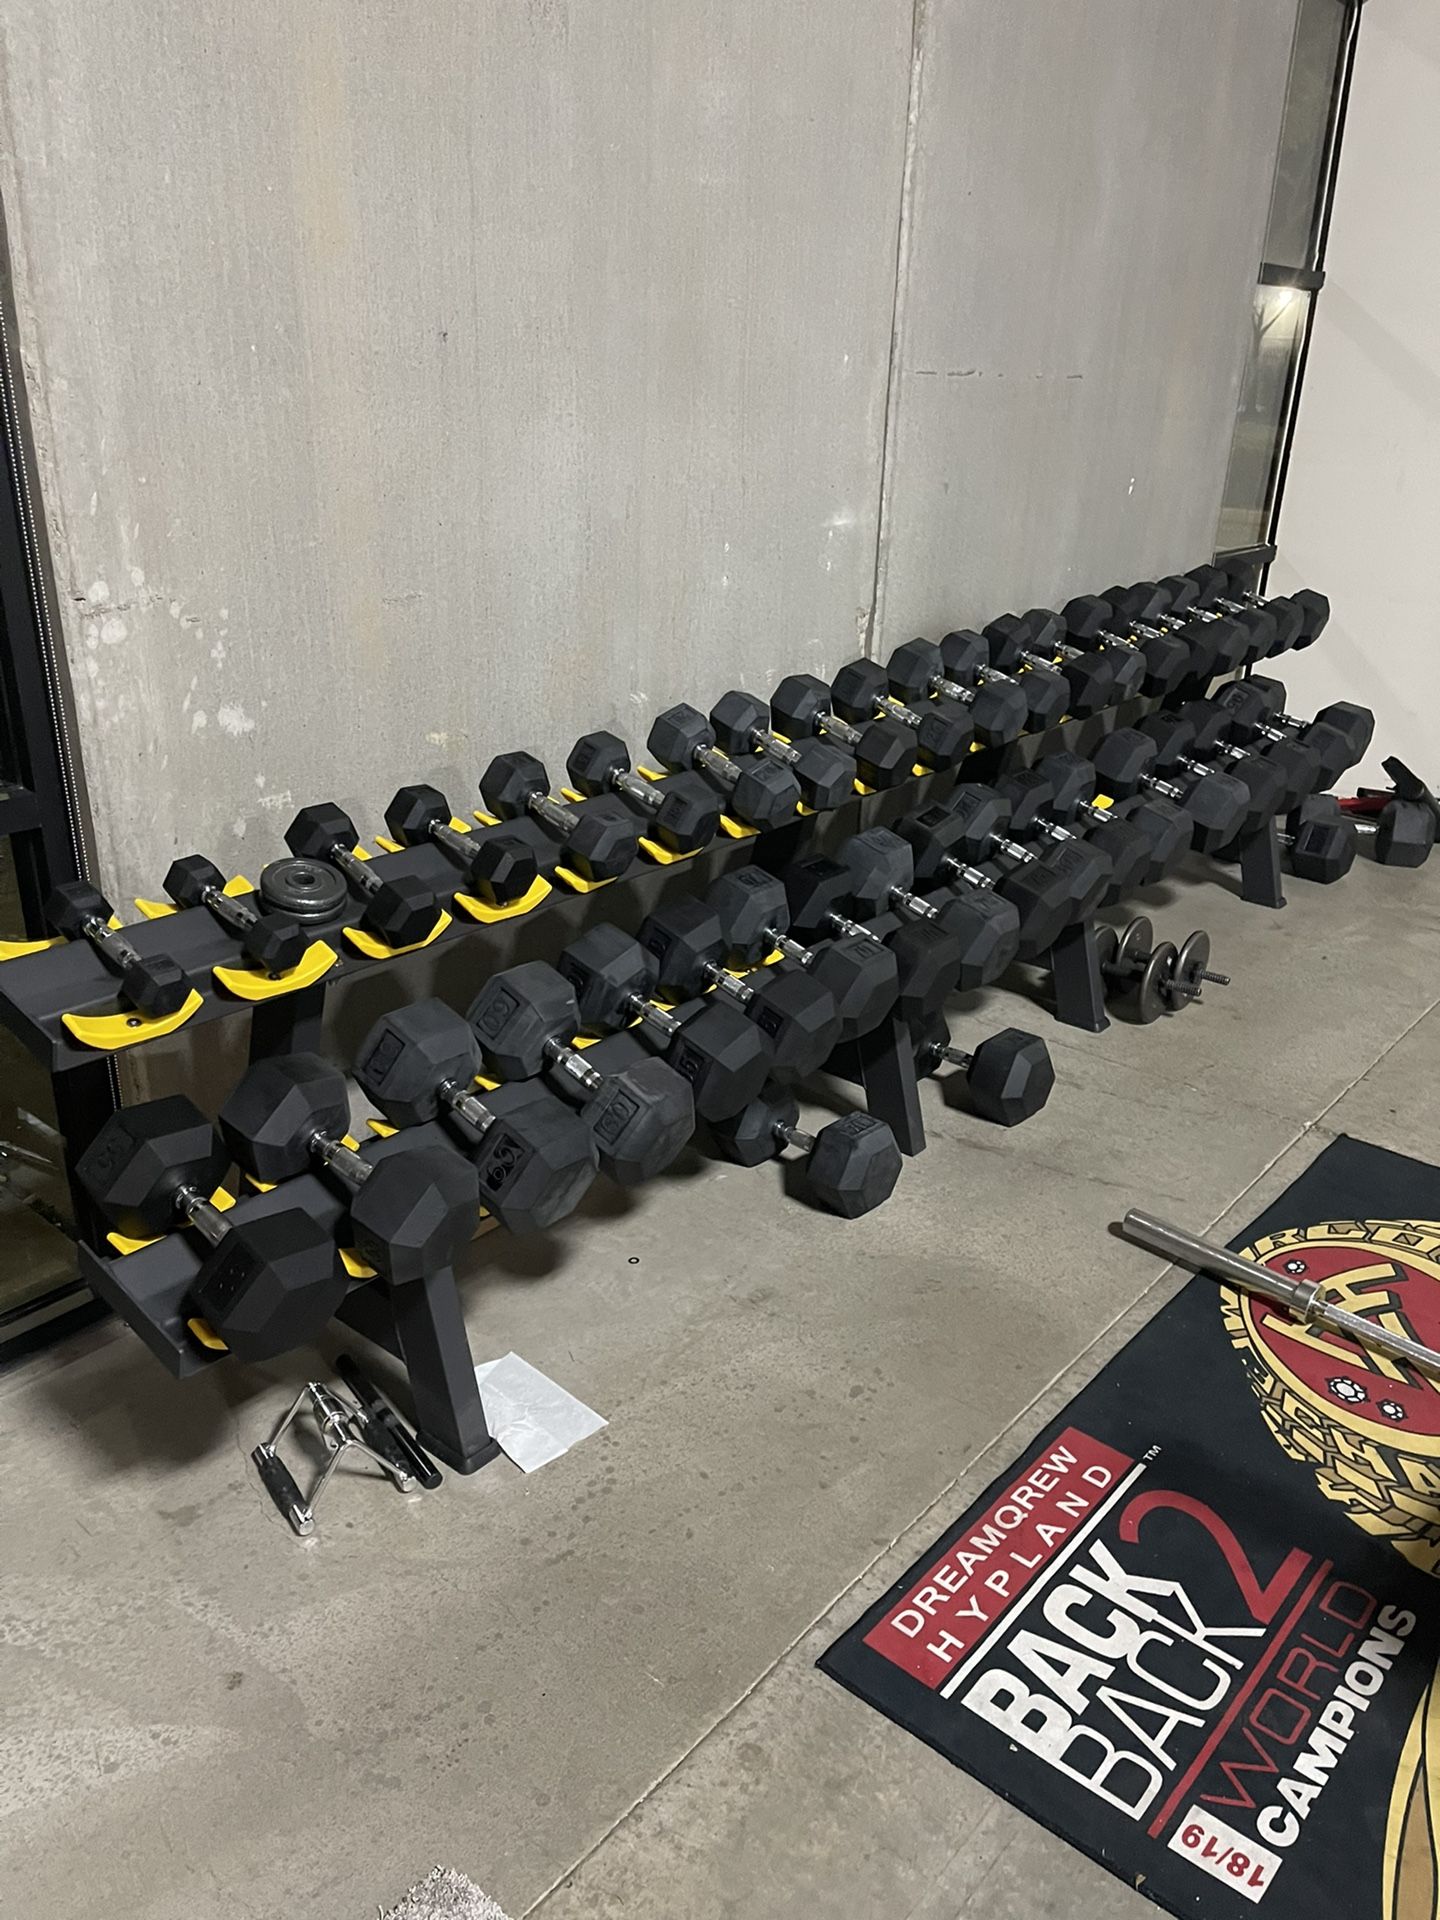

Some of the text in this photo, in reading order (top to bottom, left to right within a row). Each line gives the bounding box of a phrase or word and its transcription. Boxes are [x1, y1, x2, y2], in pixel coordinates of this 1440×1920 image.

[891, 1445, 1078, 1639] DREAMQREW
[926, 1464, 1113, 1663] HYPLAND
[961, 1490, 1311, 1755] BACK 2
[1057, 1583, 1268, 1821] BACK
[1181, 1580, 1378, 1888] 18/19 WORLD
[1256, 1604, 1416, 1847] CAMPIONS
